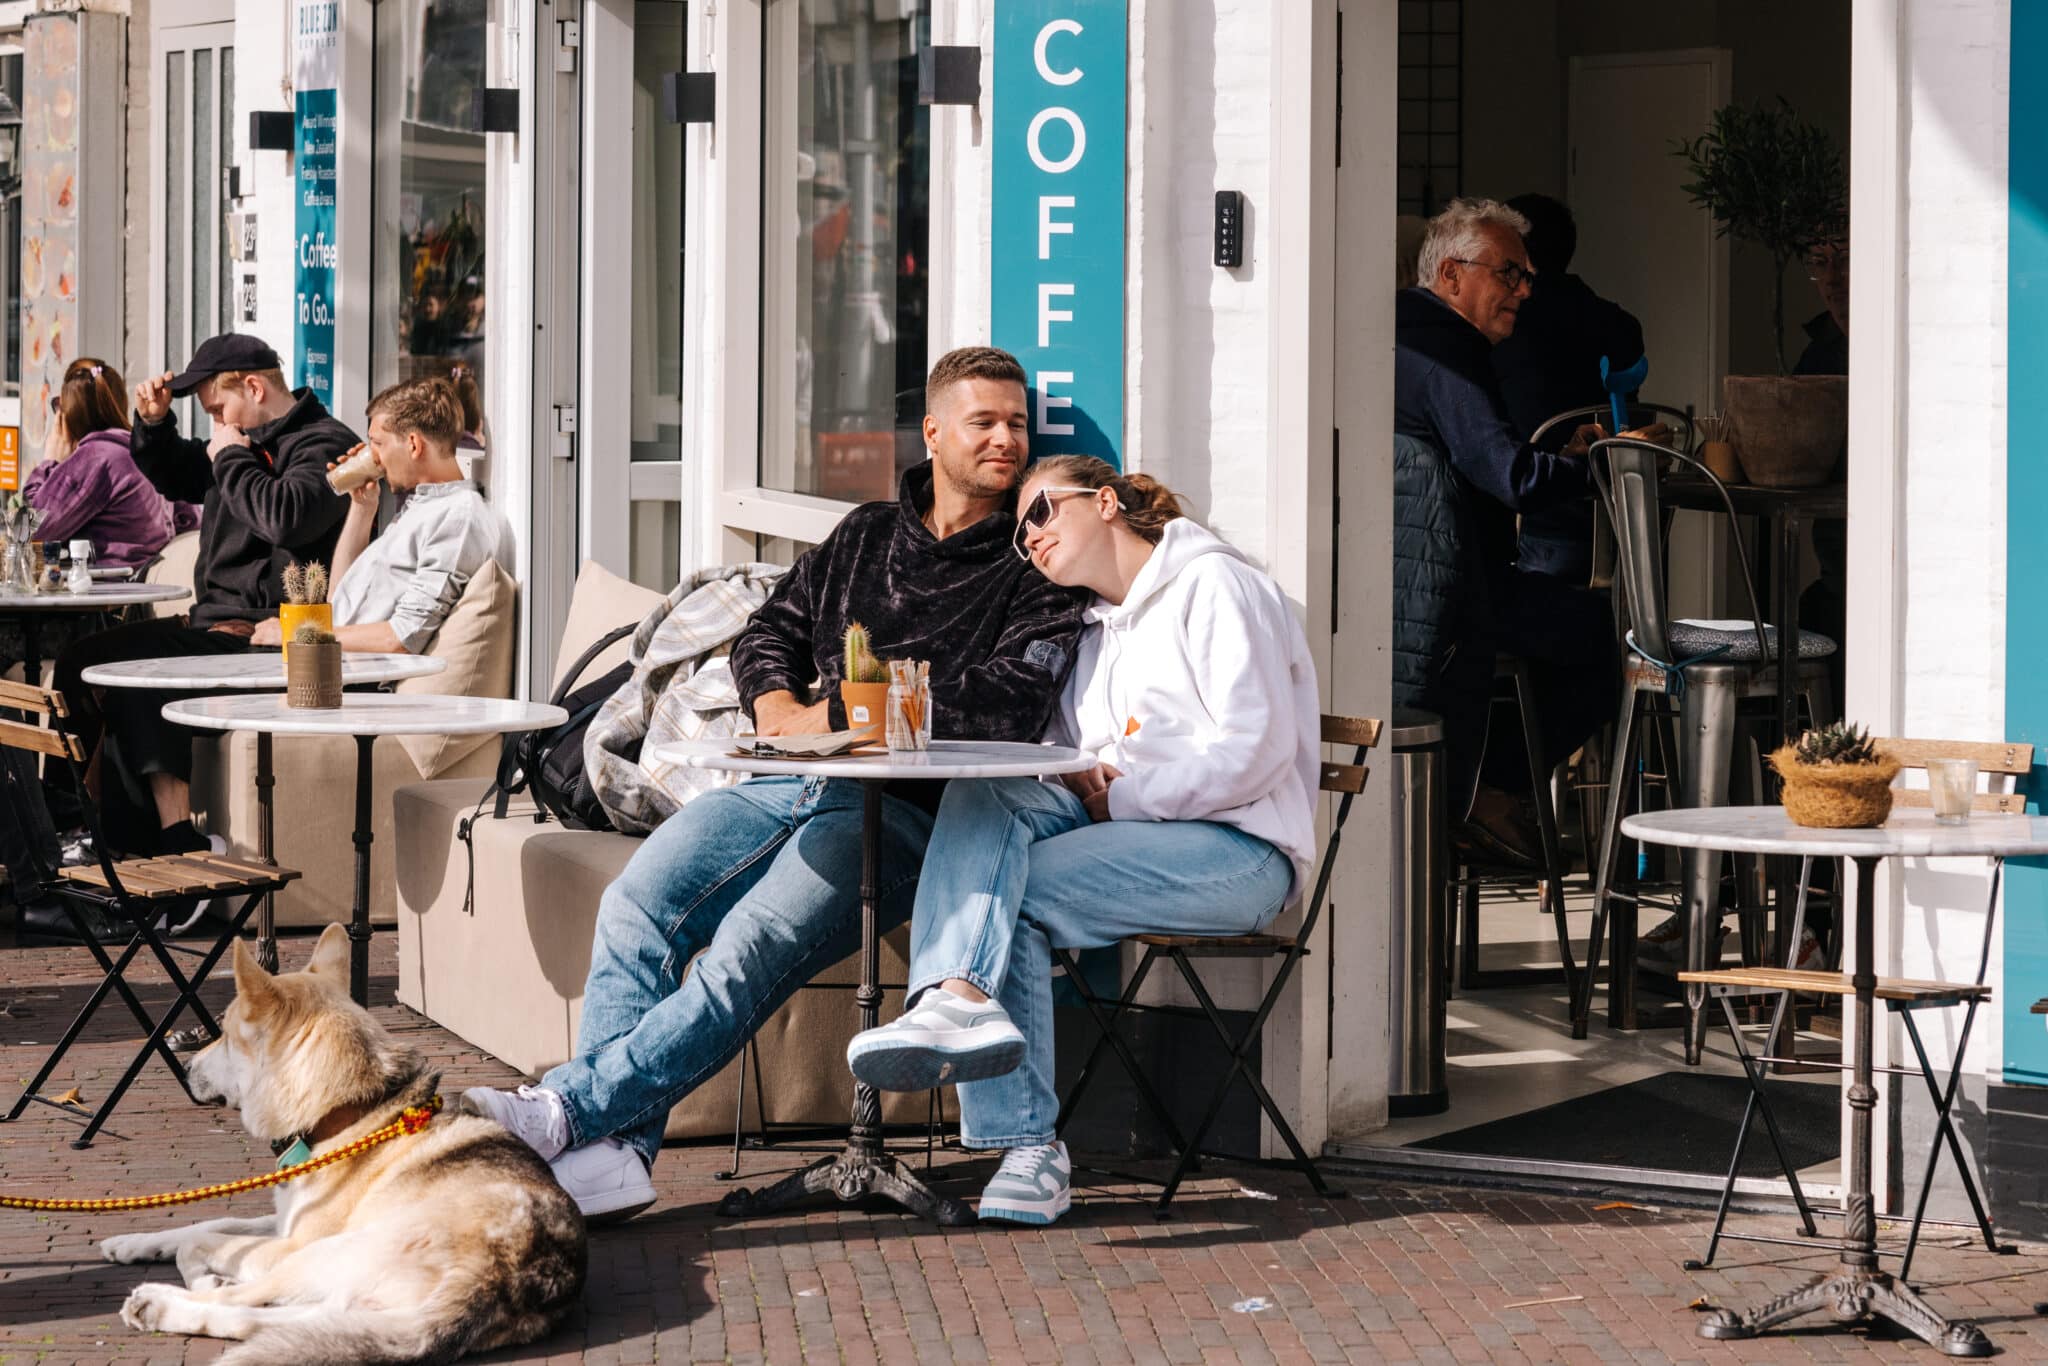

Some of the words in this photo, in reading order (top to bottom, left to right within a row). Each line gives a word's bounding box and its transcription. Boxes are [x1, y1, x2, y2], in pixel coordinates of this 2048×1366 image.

[300, 5, 320, 35] BLUE
[300, 231, 337, 269] Coffee
[1026, 18, 1087, 460] COFFE
[297, 292, 310, 325] To
